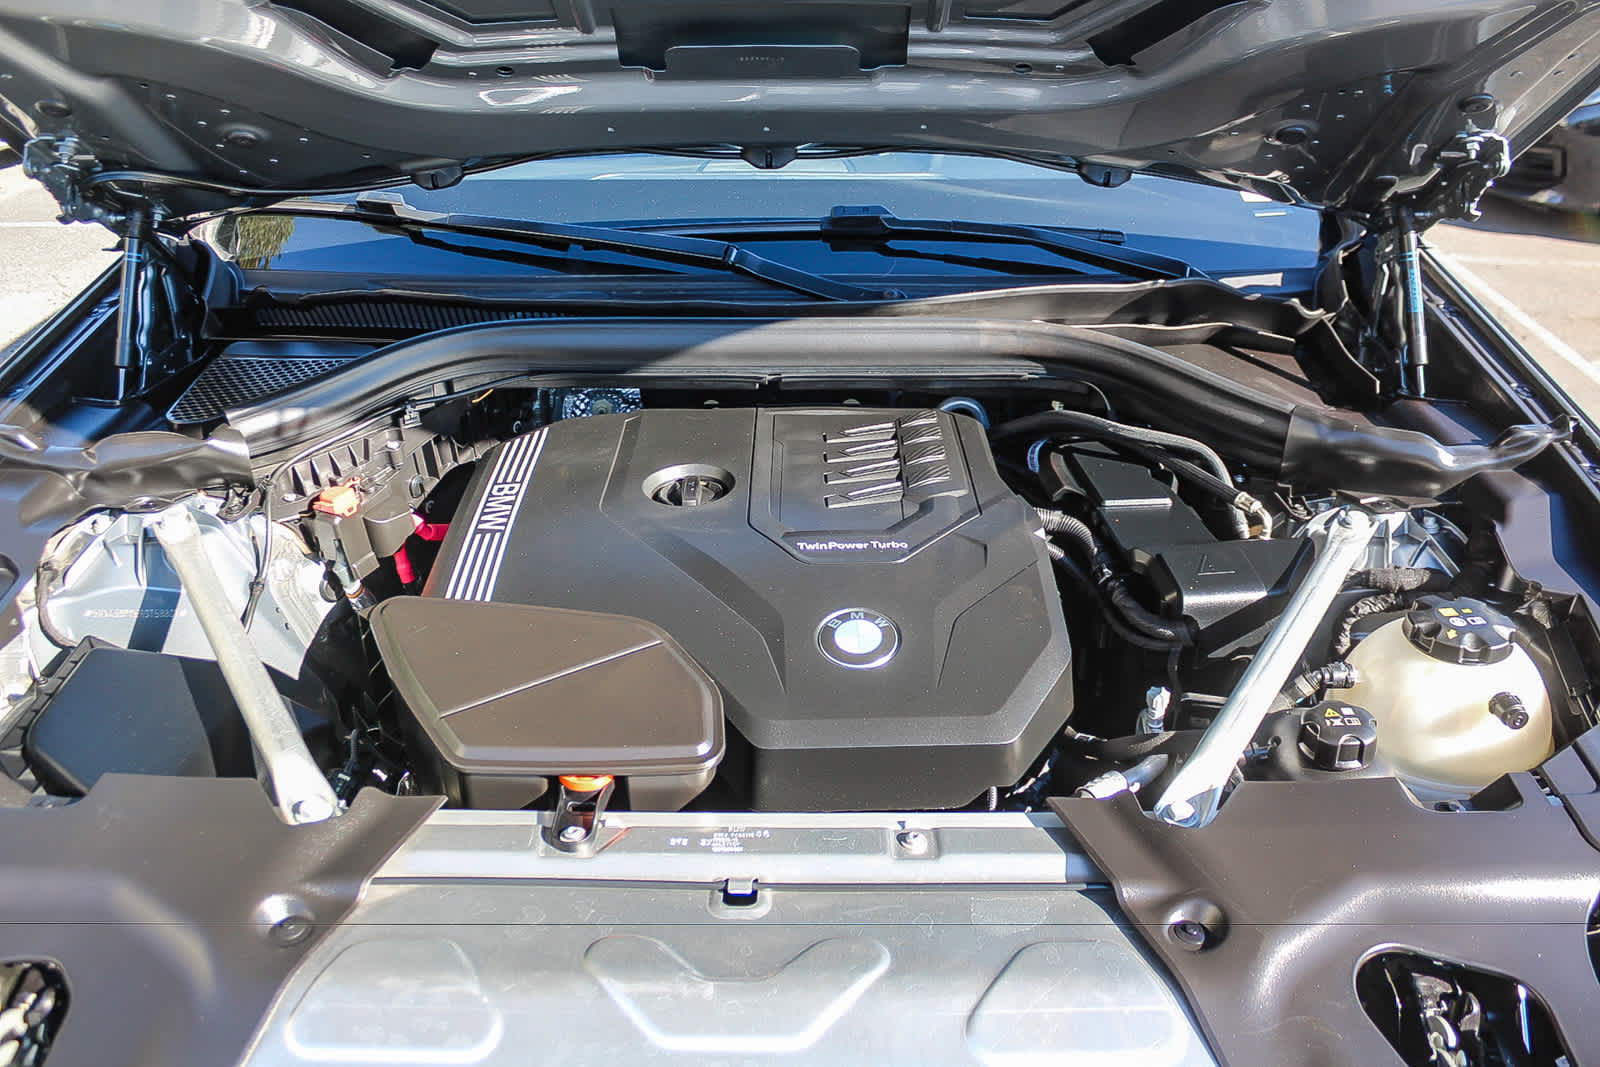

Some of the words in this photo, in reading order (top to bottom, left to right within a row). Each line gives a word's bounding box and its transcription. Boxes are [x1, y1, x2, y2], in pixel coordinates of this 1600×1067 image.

[477, 483, 521, 531] BMW
[870, 540, 908, 549] Turbo
[827, 612, 889, 629] BMW
